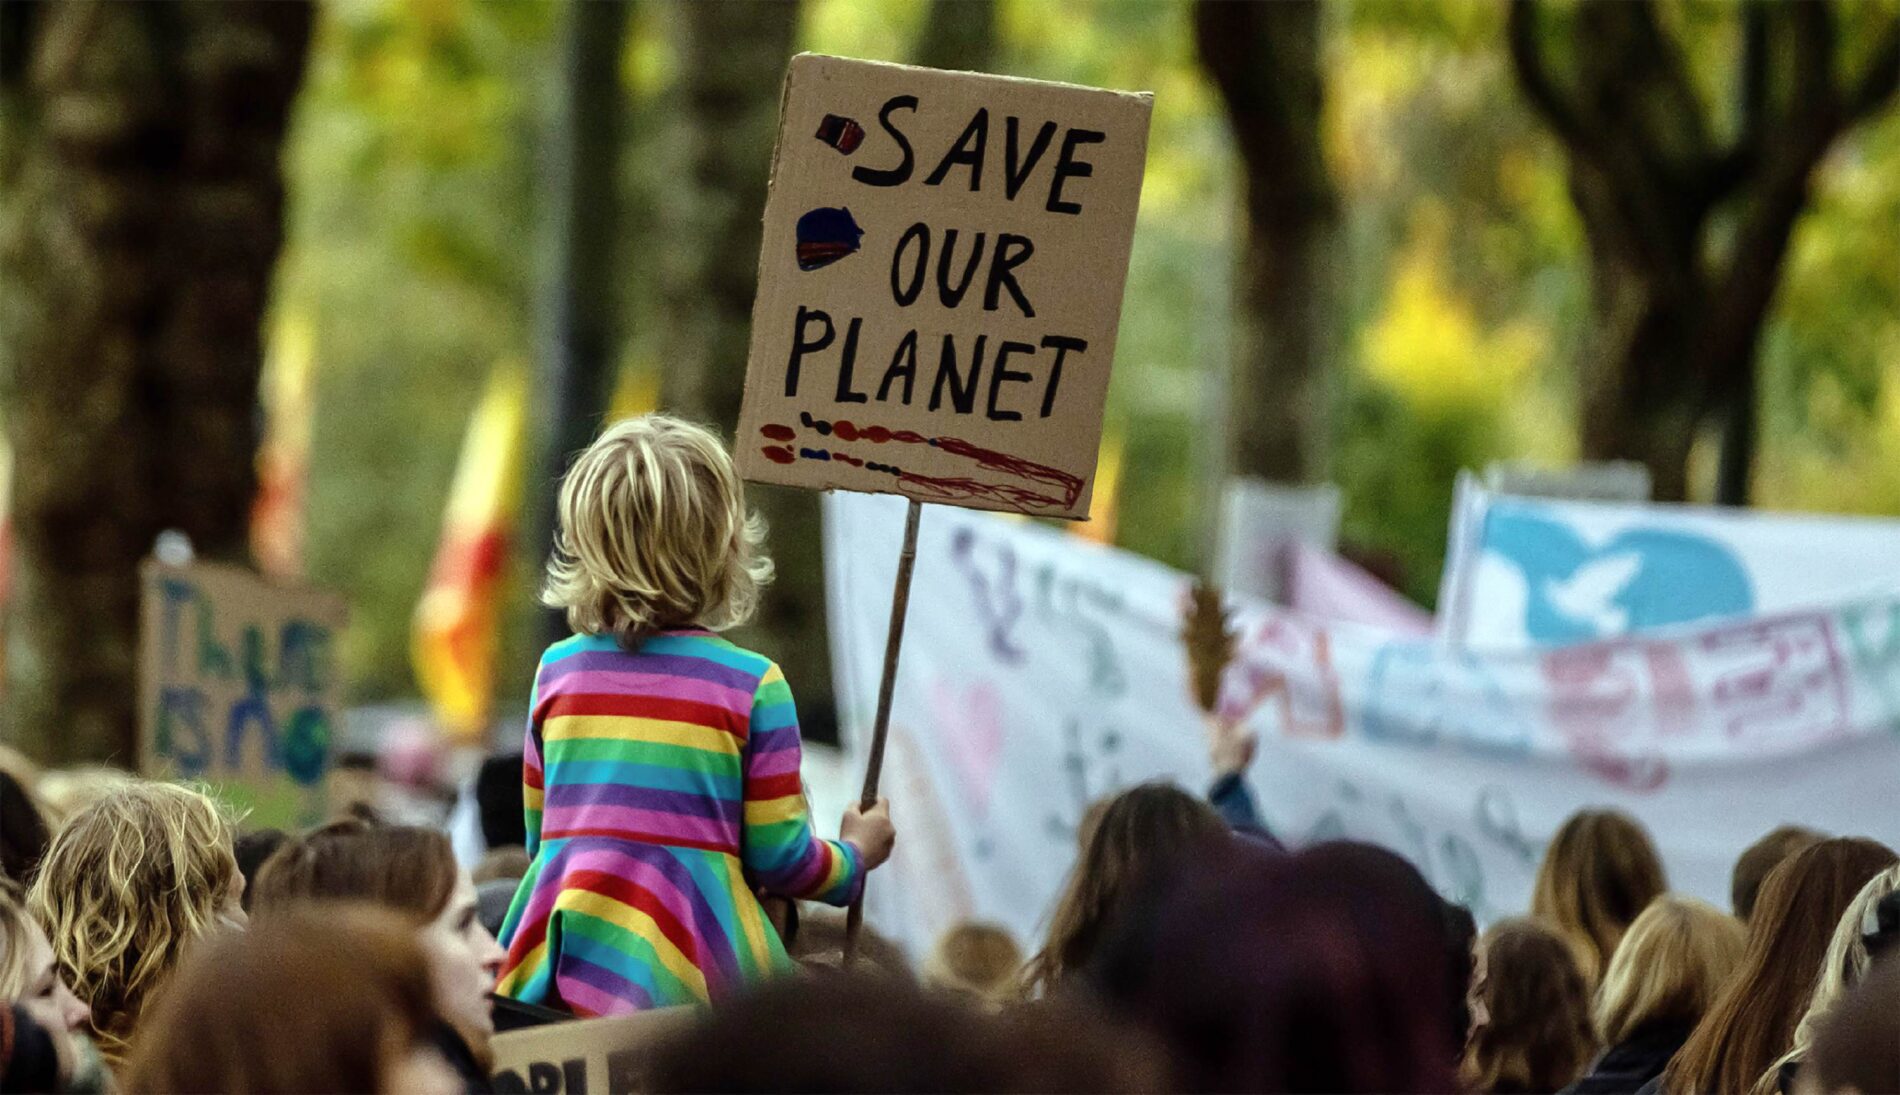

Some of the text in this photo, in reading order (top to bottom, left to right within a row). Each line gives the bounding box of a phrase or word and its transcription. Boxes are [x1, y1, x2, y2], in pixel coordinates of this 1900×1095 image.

[852, 95, 1105, 214] SAVE
[890, 222, 1036, 318] OUR
[784, 305, 1088, 421] PLANET
